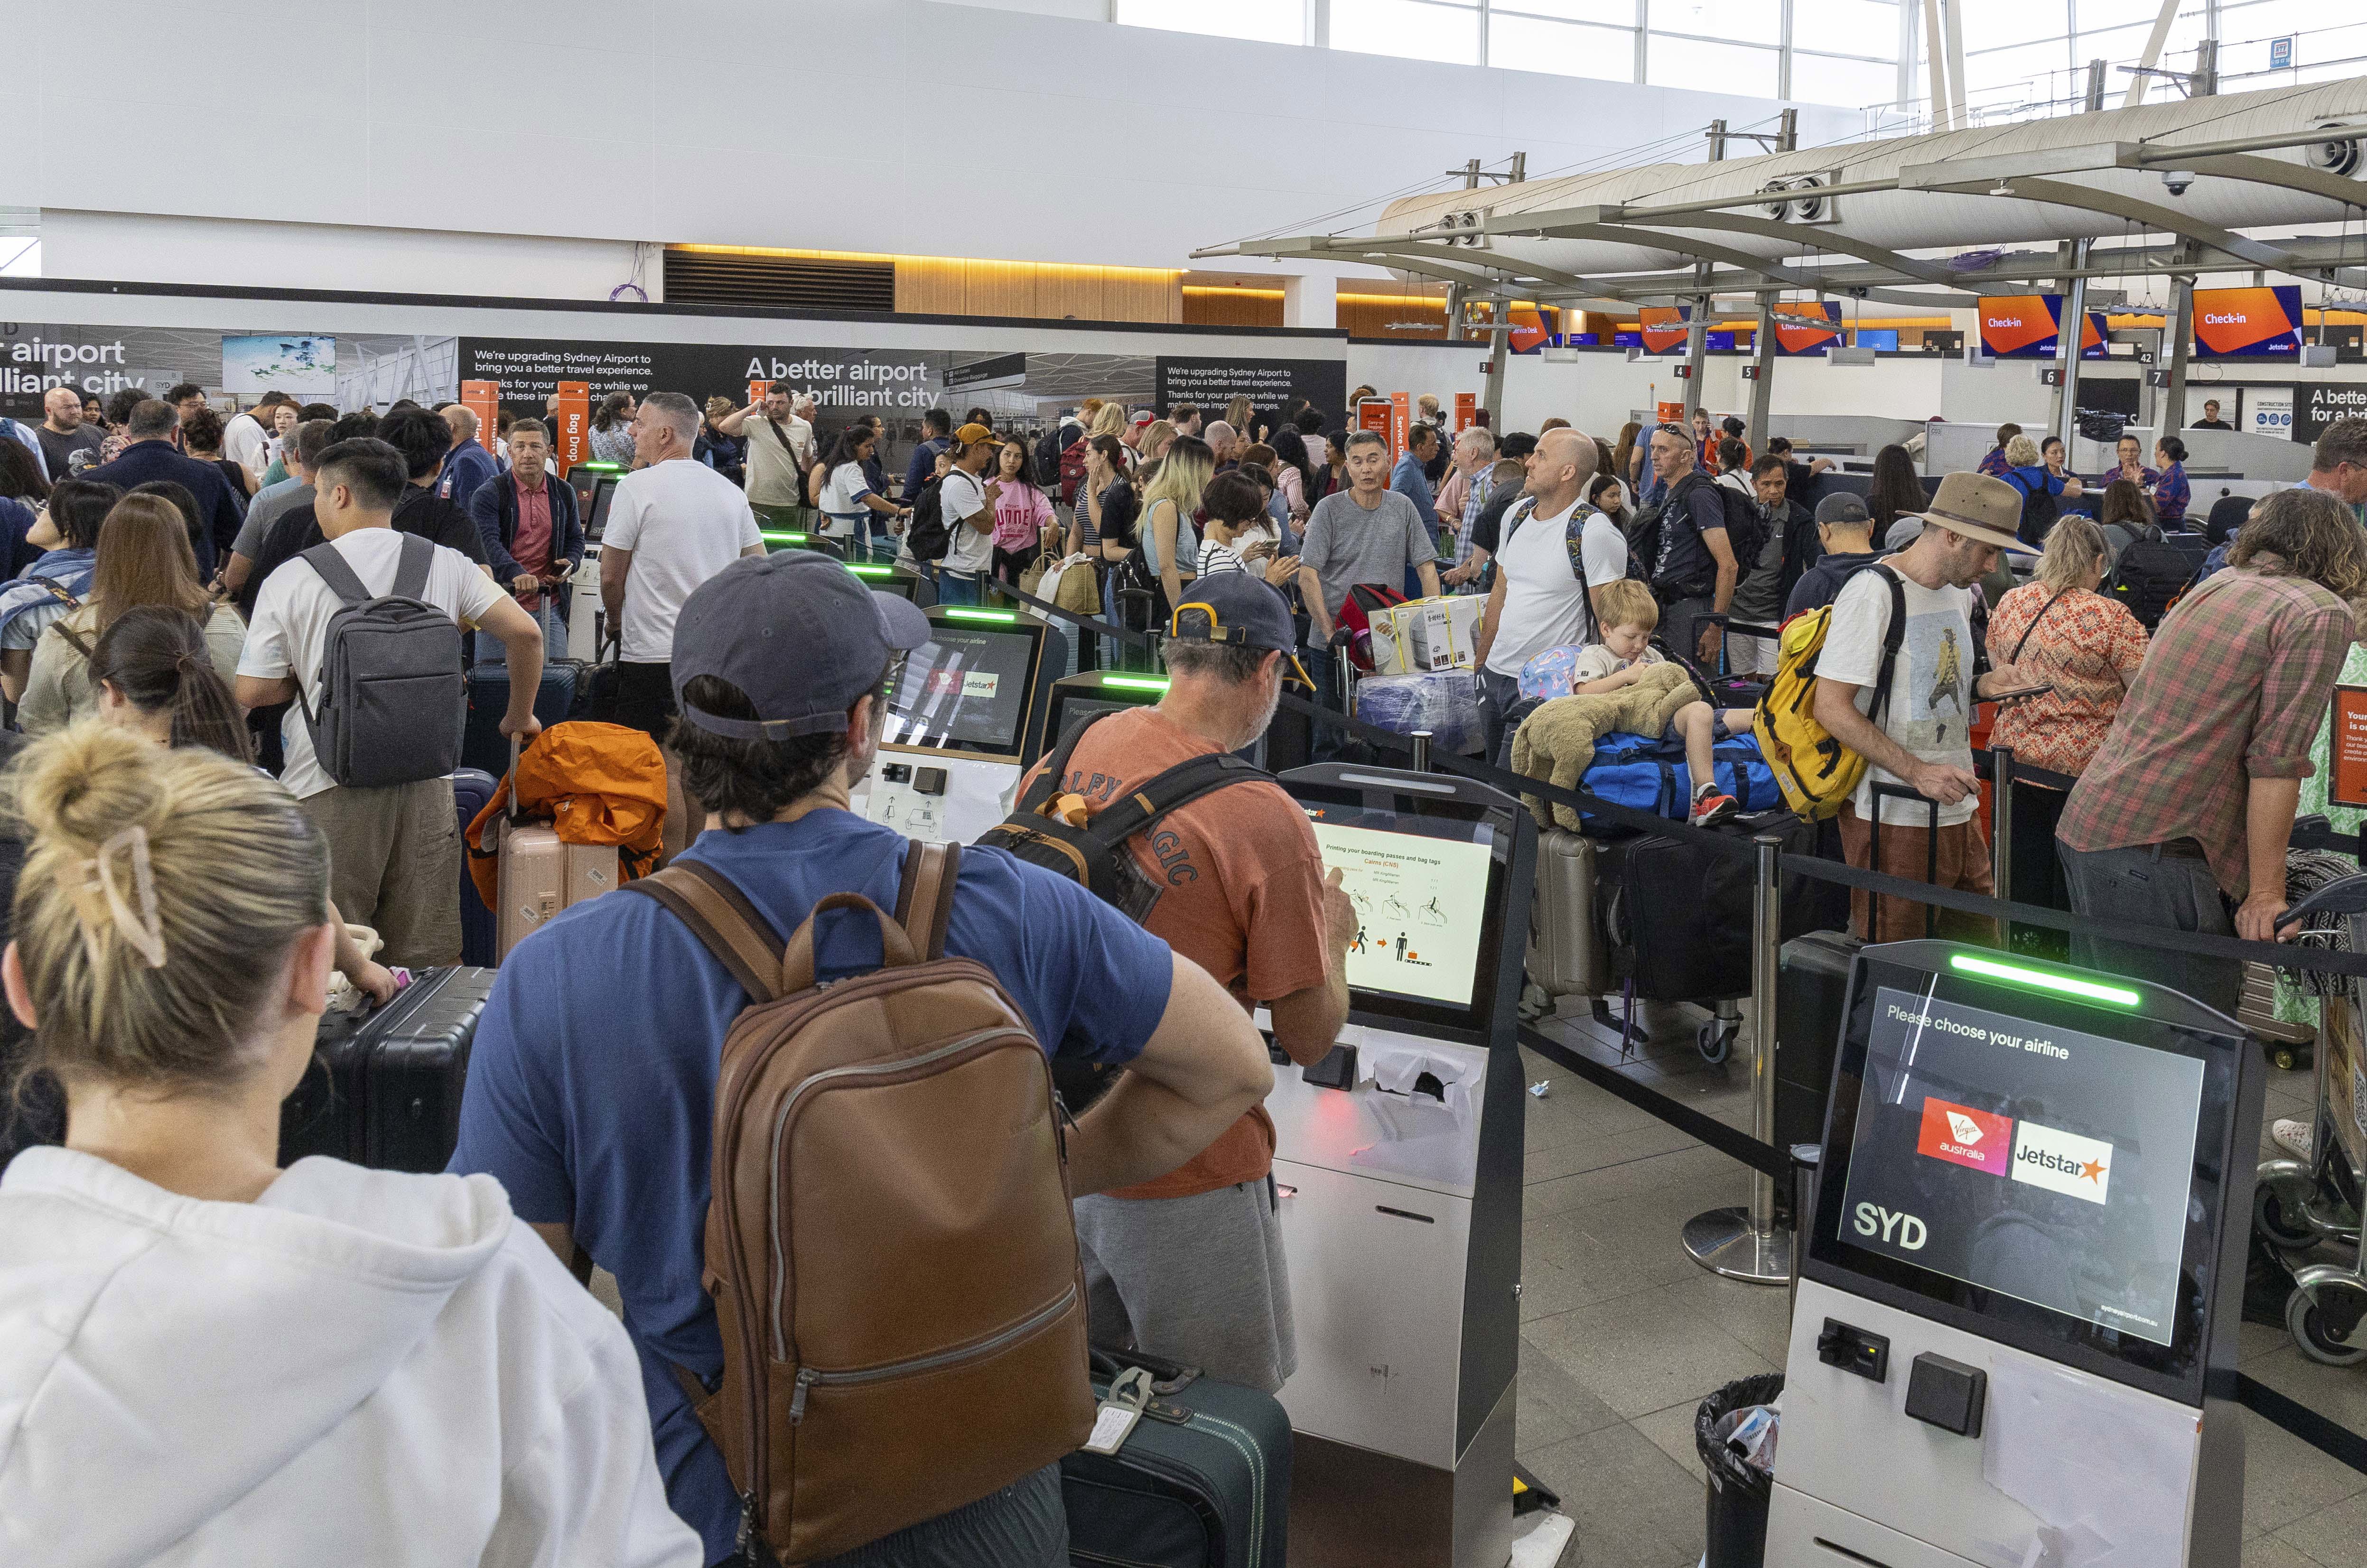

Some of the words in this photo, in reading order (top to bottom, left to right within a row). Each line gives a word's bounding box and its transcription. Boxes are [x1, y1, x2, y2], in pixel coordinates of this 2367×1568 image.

[1988, 317, 2022, 327] Check-in
[2205, 313, 2246, 324] Check-in
[12, 337, 125, 368] airport
[475, 350, 505, 360] We’re
[508, 352, 561, 363] upgrading
[563, 353, 602, 364] Sydney
[603, 354, 639, 364] Airport
[641, 355, 651, 363] to
[2141, 353, 2151, 362] 42
[475, 362, 502, 374] bring
[504, 365, 523, 373] you
[535, 364, 565, 373] better
[567, 365, 594, 374] travel
[596, 366, 653, 376] experience.
[745, 357, 765, 378] A
[772, 357, 844, 380] better
[849, 360, 927, 385] airport
[1191, 369, 1228, 377] upgrading
[1229, 368, 1256, 378] Sydney
[1482, 363, 1486, 371] 3
[1677, 368, 1682, 376] 4
[1746, 367, 1751, 376] 5
[1168, 378, 1186, 386] bring
[2047, 371, 2054, 382] 6
[2154, 372, 2161, 383] 7
[514, 379, 530, 388] for
[532, 381, 555, 390] your
[604, 382, 631, 390] while
[507, 392, 535, 400] these
[808, 385, 892, 406] brilliant
[898, 386, 940, 409] city
[2311, 390, 2324, 403] A
[2328, 390, 2367, 404] bette
[1252, 402, 1280, 410] hanges.
[2311, 407, 2332, 421] for
[567, 414, 580, 434] Bag
[566, 436, 580, 461] Drop
[964, 680, 988, 689] Jetstar
[1326, 844, 1346, 853] Printing
[1361, 849, 1385, 858] boarding
[1887, 1005, 1932, 1027] Please
[1935, 1018, 1986, 1040] choose
[1990, 1031, 2022, 1048] your
[2024, 1039, 2069, 1060] airline
[1954, 1120, 1978, 1140] Virgin
[1939, 1141, 1985, 1161] australia
[2016, 1145, 2083, 1176] Jetstar
[1854, 1202, 1927, 1250] SYD
[2101, 1305, 2158, 1327] sydneyairport.com.au
